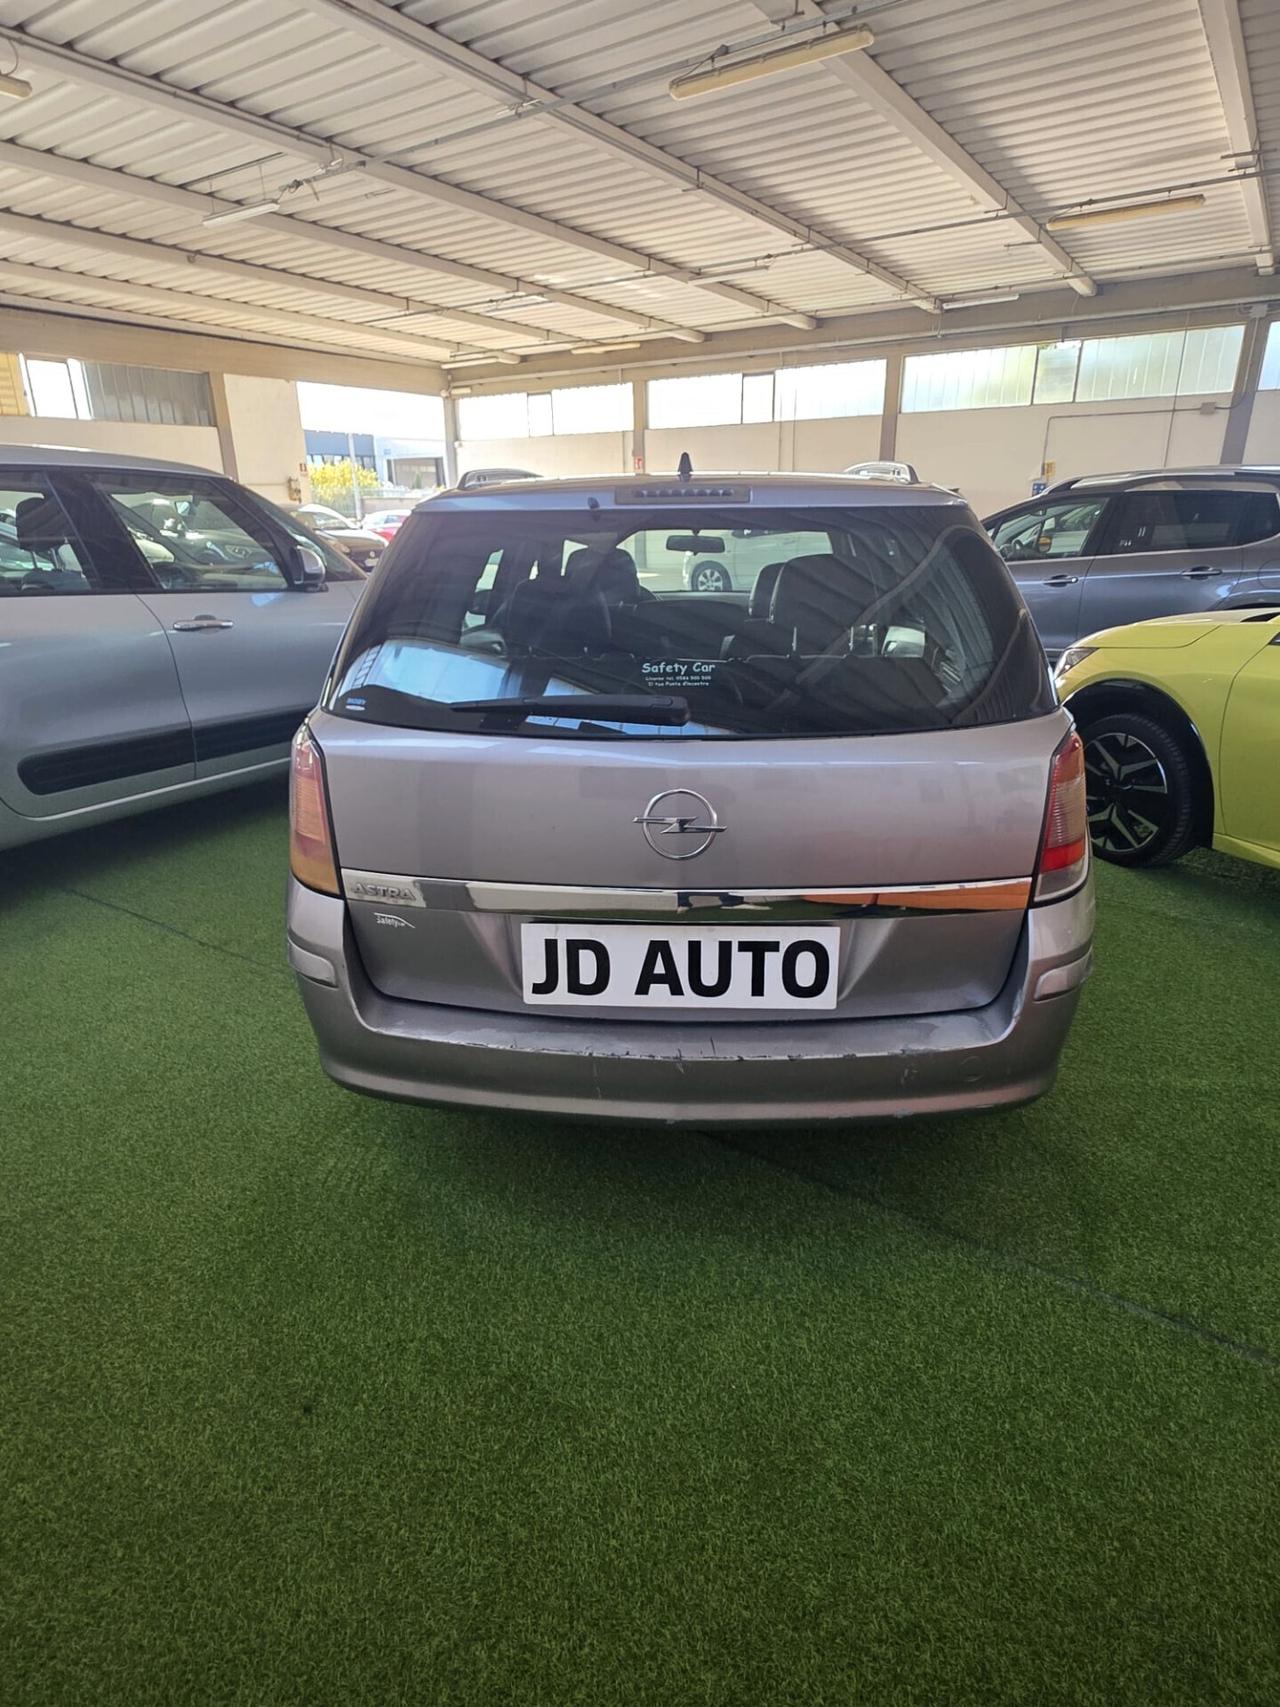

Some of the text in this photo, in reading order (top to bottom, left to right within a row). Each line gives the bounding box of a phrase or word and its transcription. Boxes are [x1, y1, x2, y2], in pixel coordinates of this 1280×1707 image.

[641, 662, 716, 675] Safety Car
[353, 883, 417, 901] ASTRA
[531, 938, 830, 999] JD AUTO
